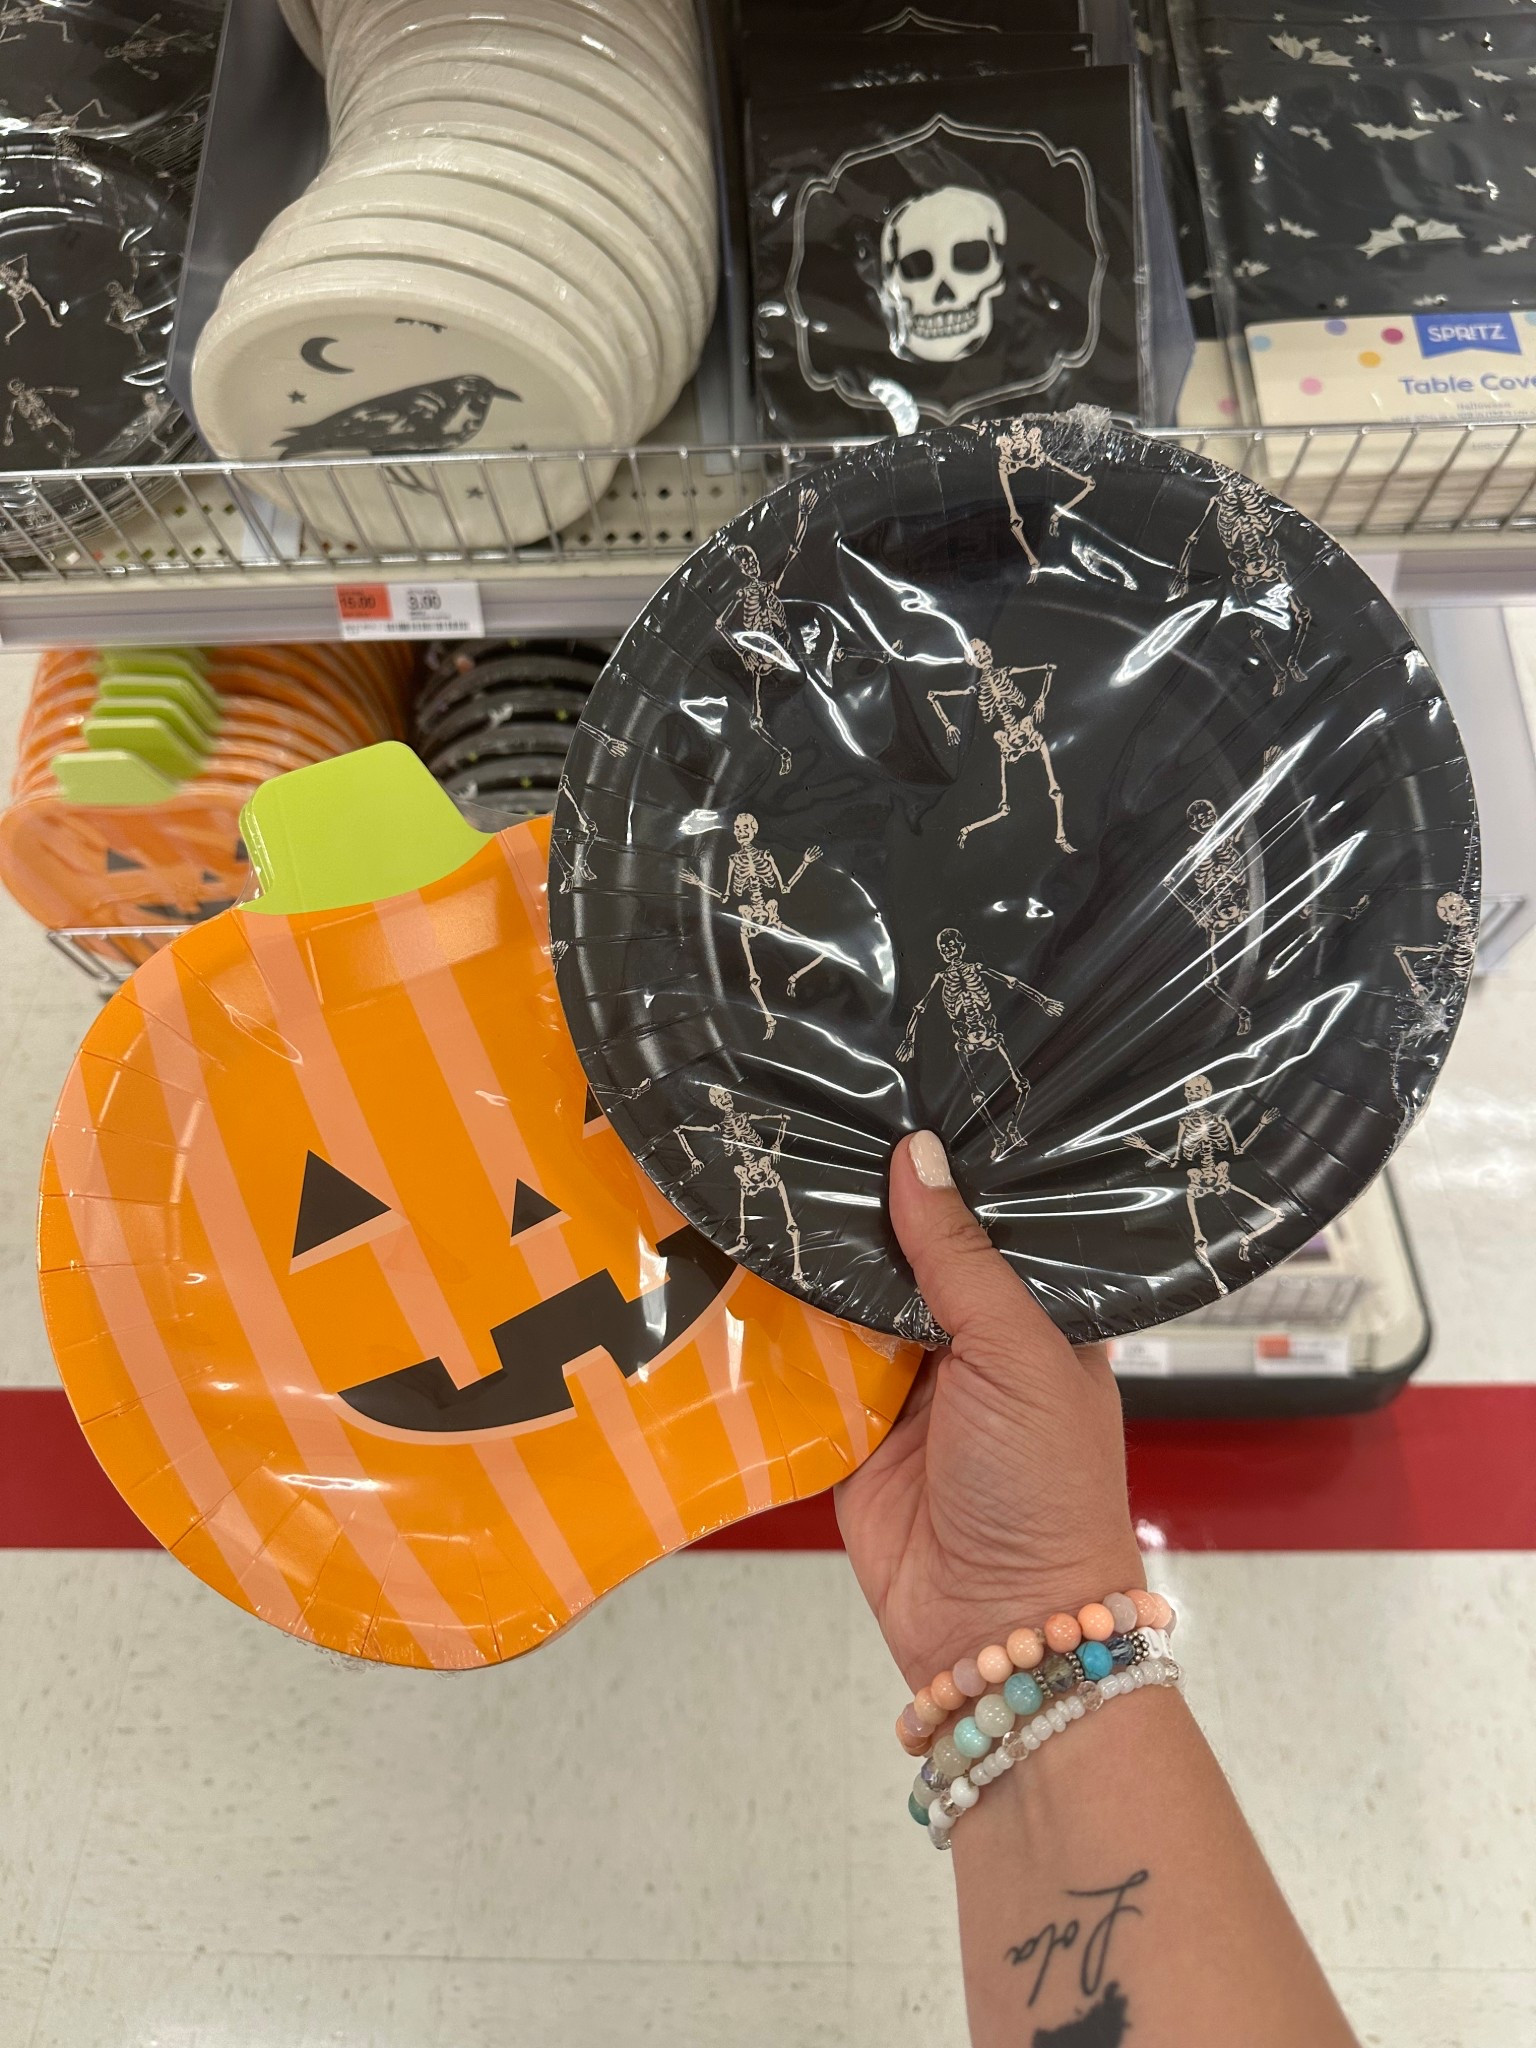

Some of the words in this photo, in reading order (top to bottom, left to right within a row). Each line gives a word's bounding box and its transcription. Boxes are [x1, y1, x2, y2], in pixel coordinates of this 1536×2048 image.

[1427, 323, 1508, 342] SPRITZ
[1399, 374, 1474, 394] Table
[1004, 1868, 1148, 2008] Lola
